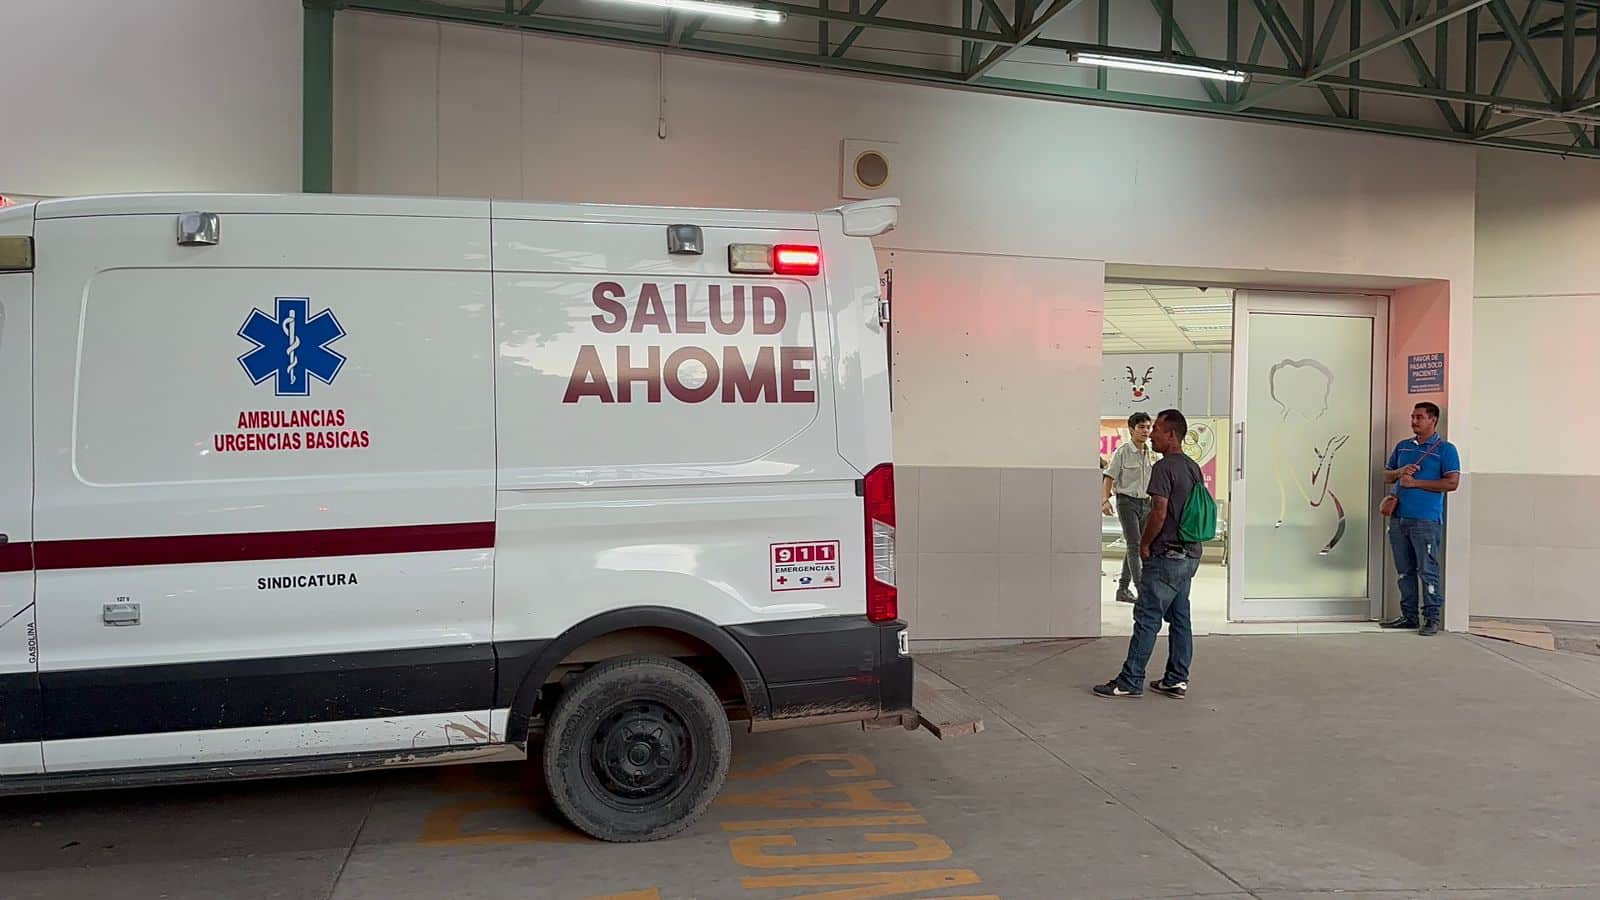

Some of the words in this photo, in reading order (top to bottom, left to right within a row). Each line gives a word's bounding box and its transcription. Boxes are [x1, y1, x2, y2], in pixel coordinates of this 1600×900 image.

[591, 281, 787, 335] SALUD
[562, 345, 815, 404] AHOME
[1428, 361, 1443, 369] SOLO
[237, 409, 345, 429] AMBULANCIAS
[214, 432, 301, 452] URGENCIAS
[306, 430, 370, 449] BASICAS
[779, 547, 829, 561] 911
[257, 572, 358, 590] SINDICATURA
[27, 622, 36, 664] GASOLINA
